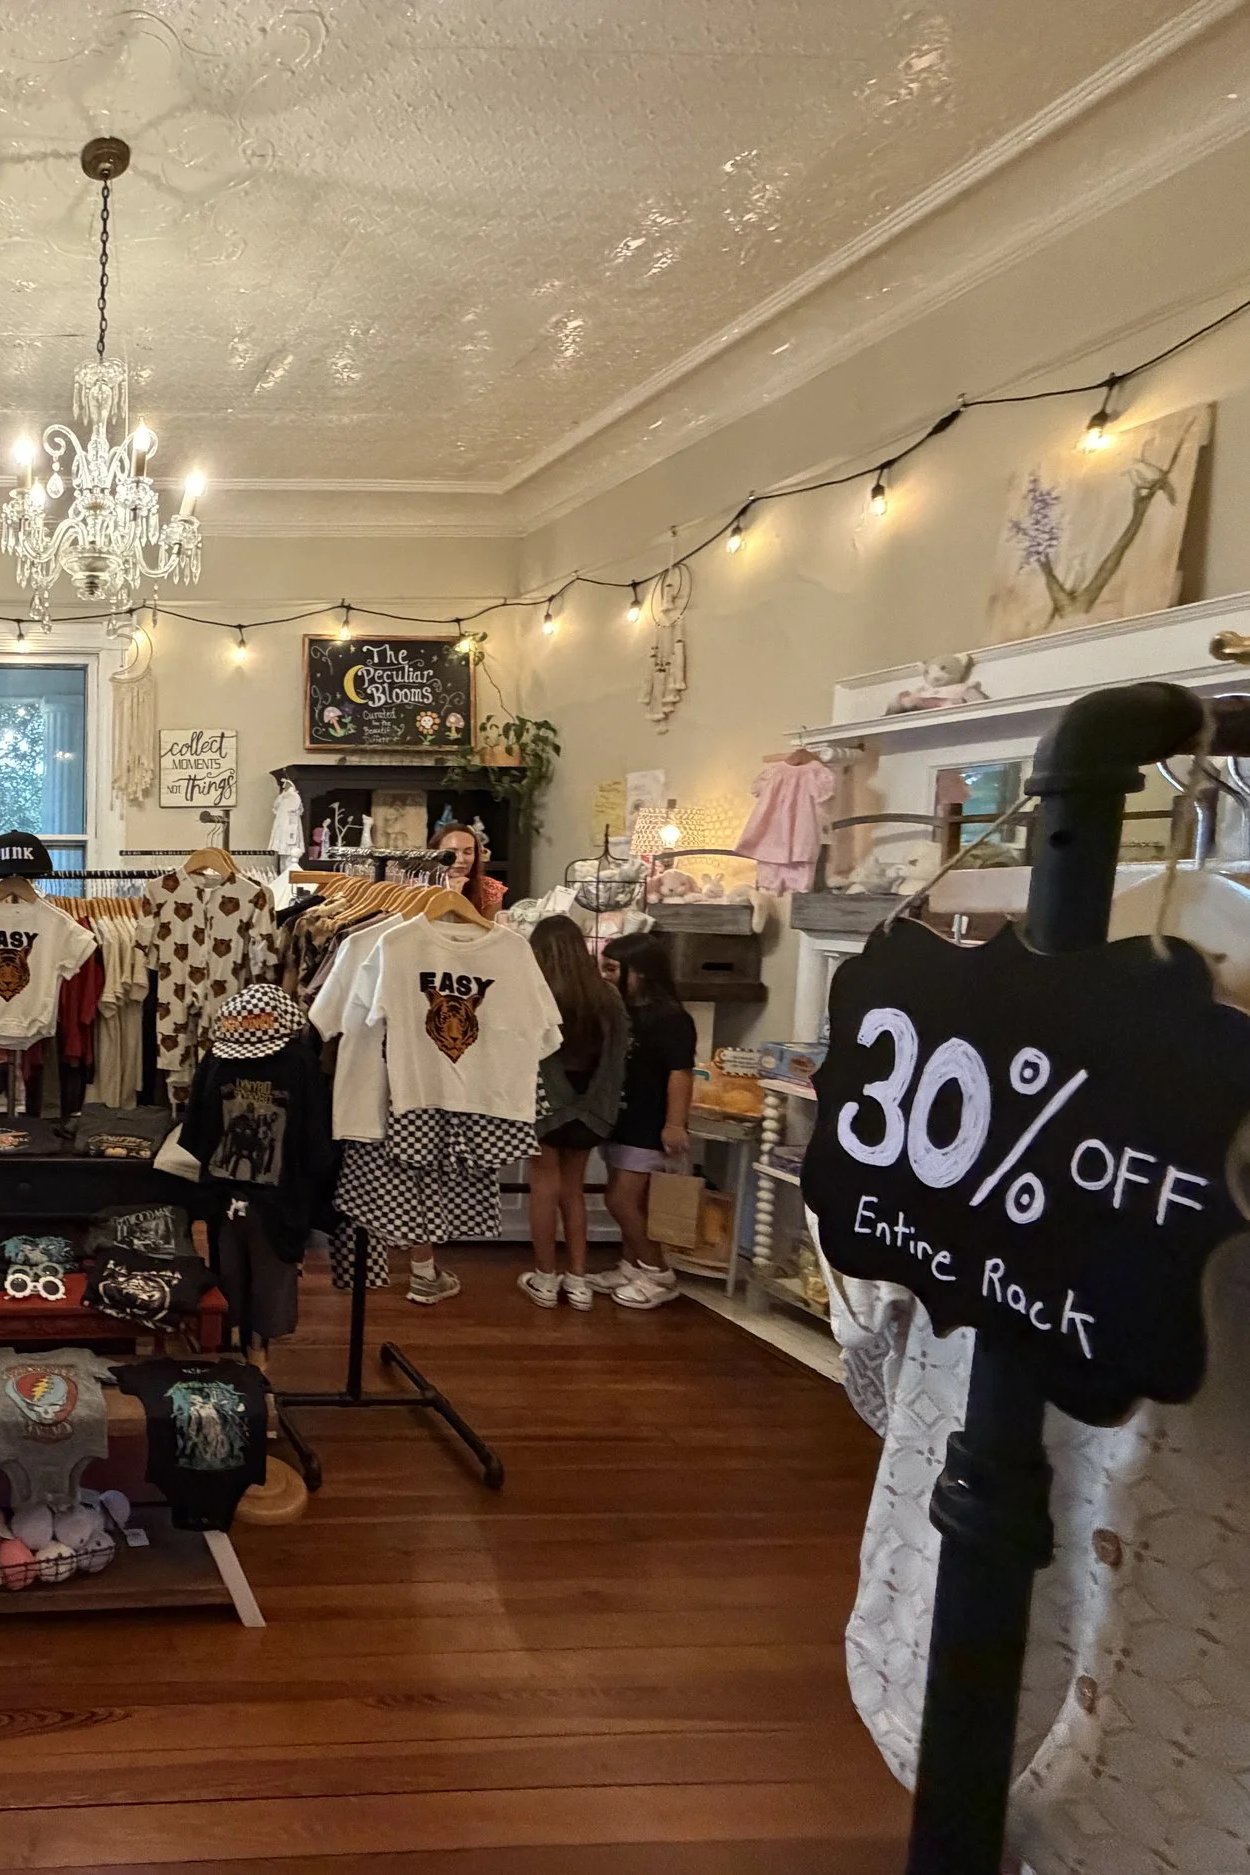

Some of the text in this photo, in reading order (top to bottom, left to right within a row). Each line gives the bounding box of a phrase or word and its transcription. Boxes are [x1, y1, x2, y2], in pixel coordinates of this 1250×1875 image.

[362, 644, 409, 665] The
[357, 664, 434, 688] Peculiar
[366, 683, 434, 707] Blooms
[162, 731, 234, 758] collect
[172, 759, 222, 770] MOMENTS
[166, 771, 235, 806] NOT things
[419, 971, 496, 998] EASY
[837, 1007, 1211, 1226] 30% OFF
[853, 1194, 1096, 1360] Entire Rack
